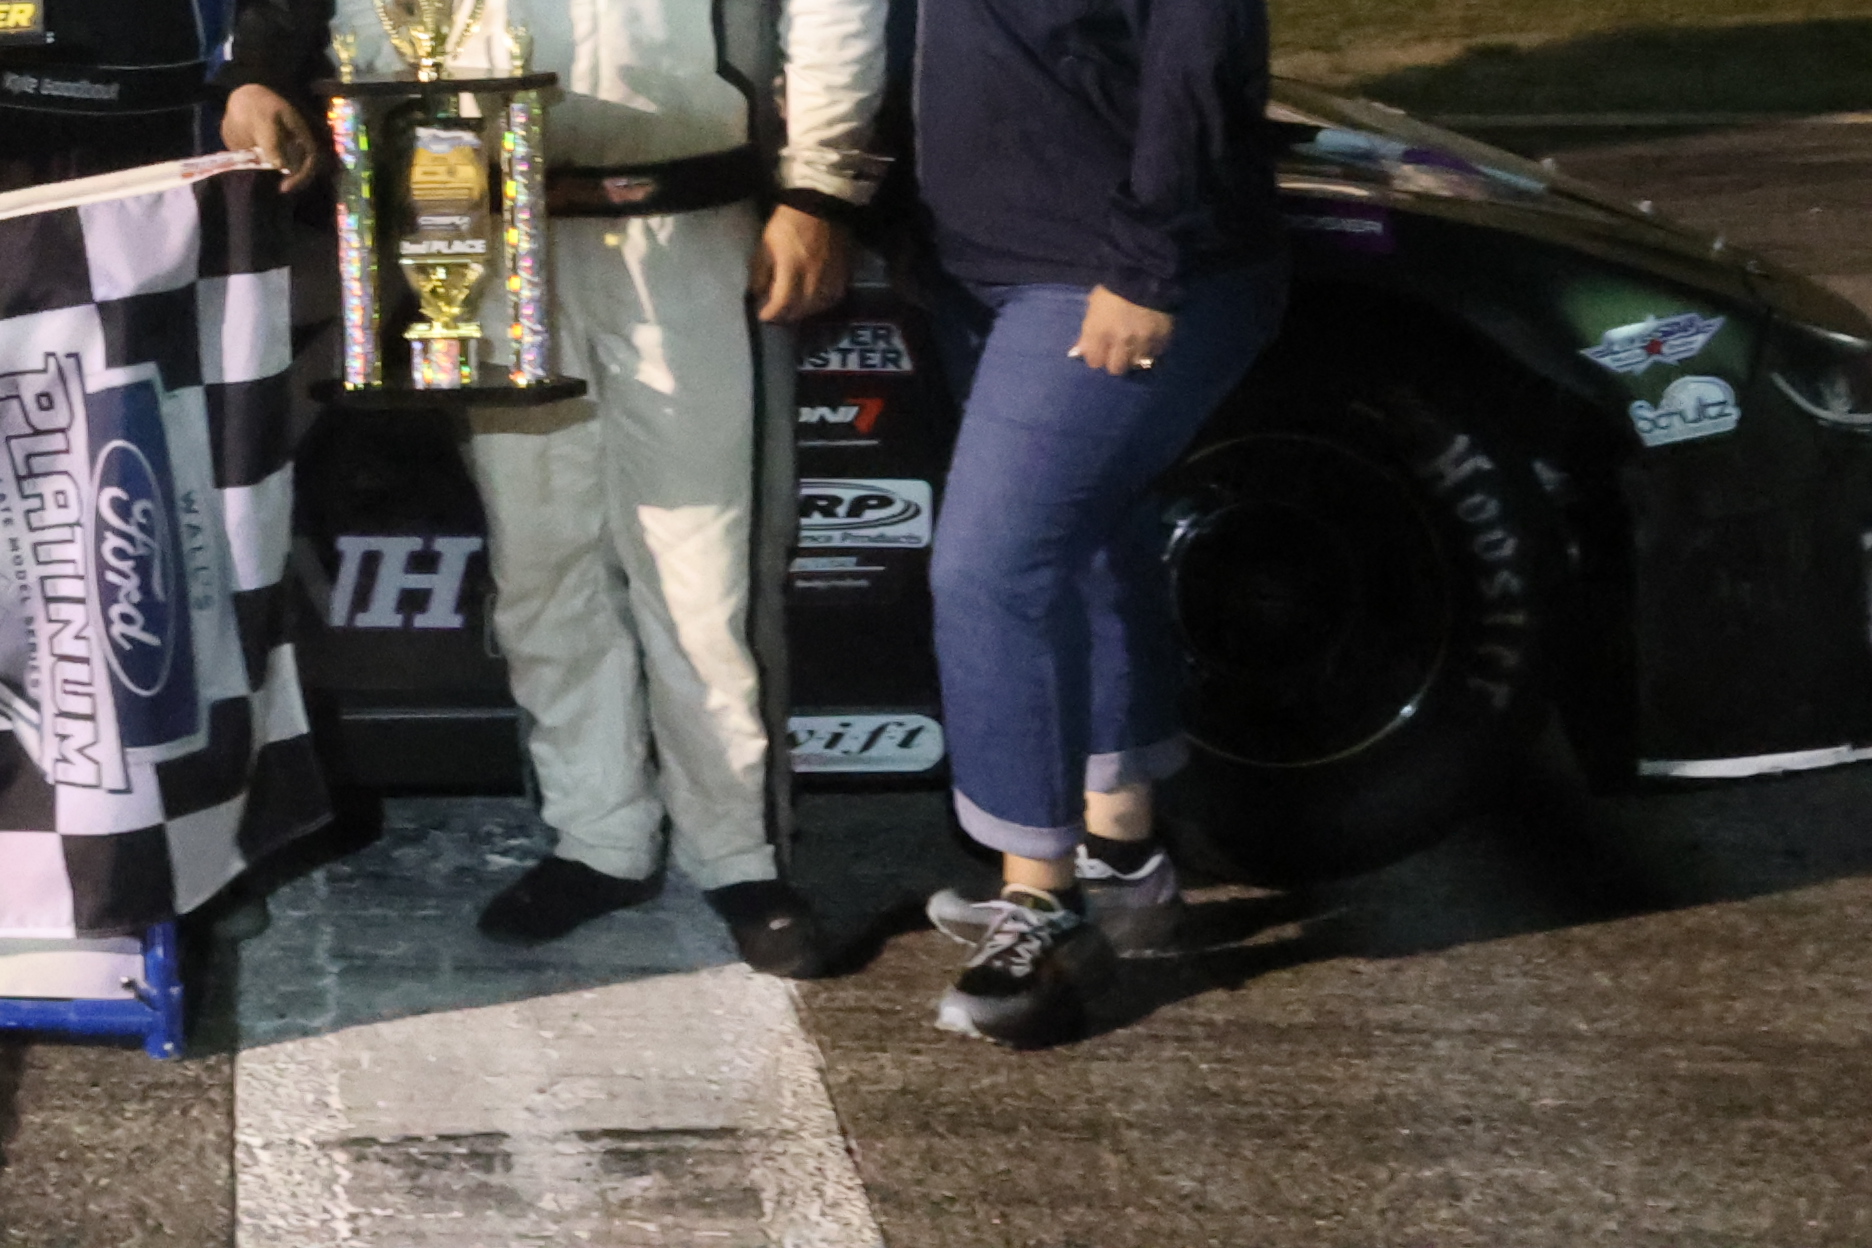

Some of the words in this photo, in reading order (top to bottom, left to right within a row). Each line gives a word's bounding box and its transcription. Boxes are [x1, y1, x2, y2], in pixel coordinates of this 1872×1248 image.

[7, 536, 31, 606] MODEL
[97, 485, 175, 652] Ford
[179, 489, 215, 613] WALL'S
